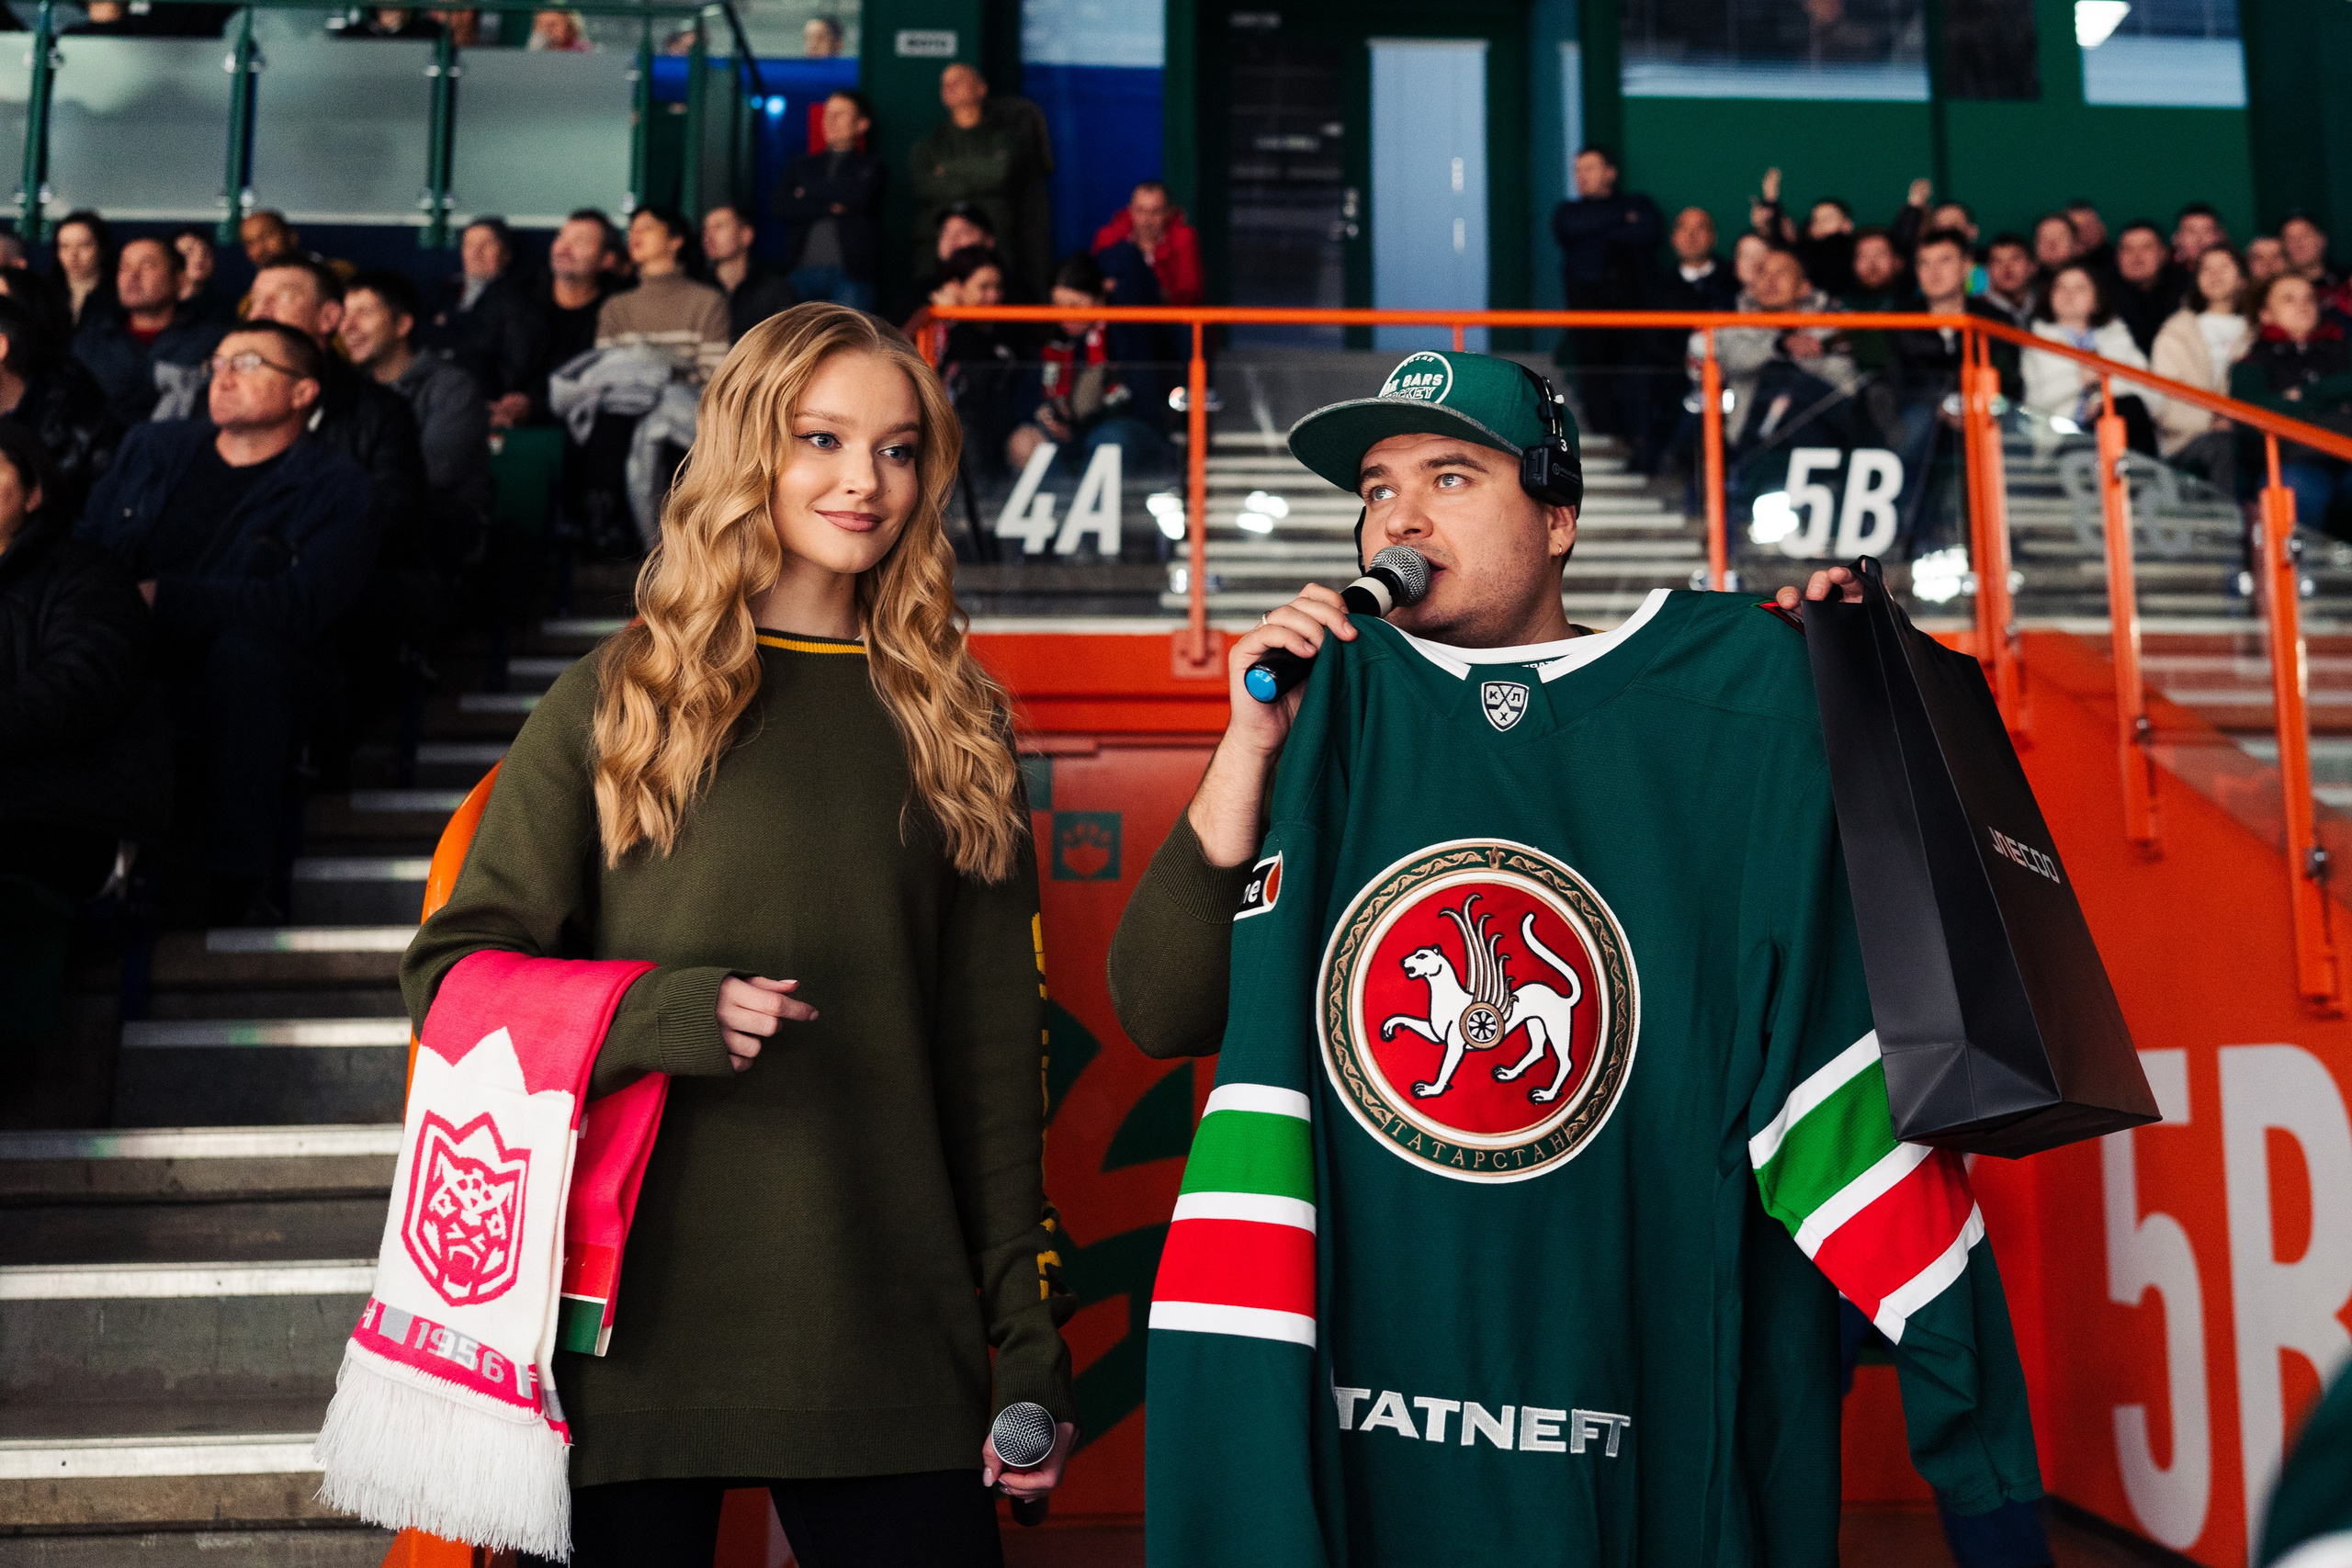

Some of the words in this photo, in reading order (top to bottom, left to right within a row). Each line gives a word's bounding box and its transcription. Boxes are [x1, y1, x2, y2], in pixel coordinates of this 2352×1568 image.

[1402, 372, 1444, 388] BARS
[1560, 438, 1568, 452] 3
[995, 442, 1122, 555] 4A
[1781, 446, 1905, 558] 5B
[1391, 1119, 1566, 1168] ТАТАРСТАН
[415, 1321, 505, 1383] 1956
[1334, 1387, 1631, 1457] TATNEFT
